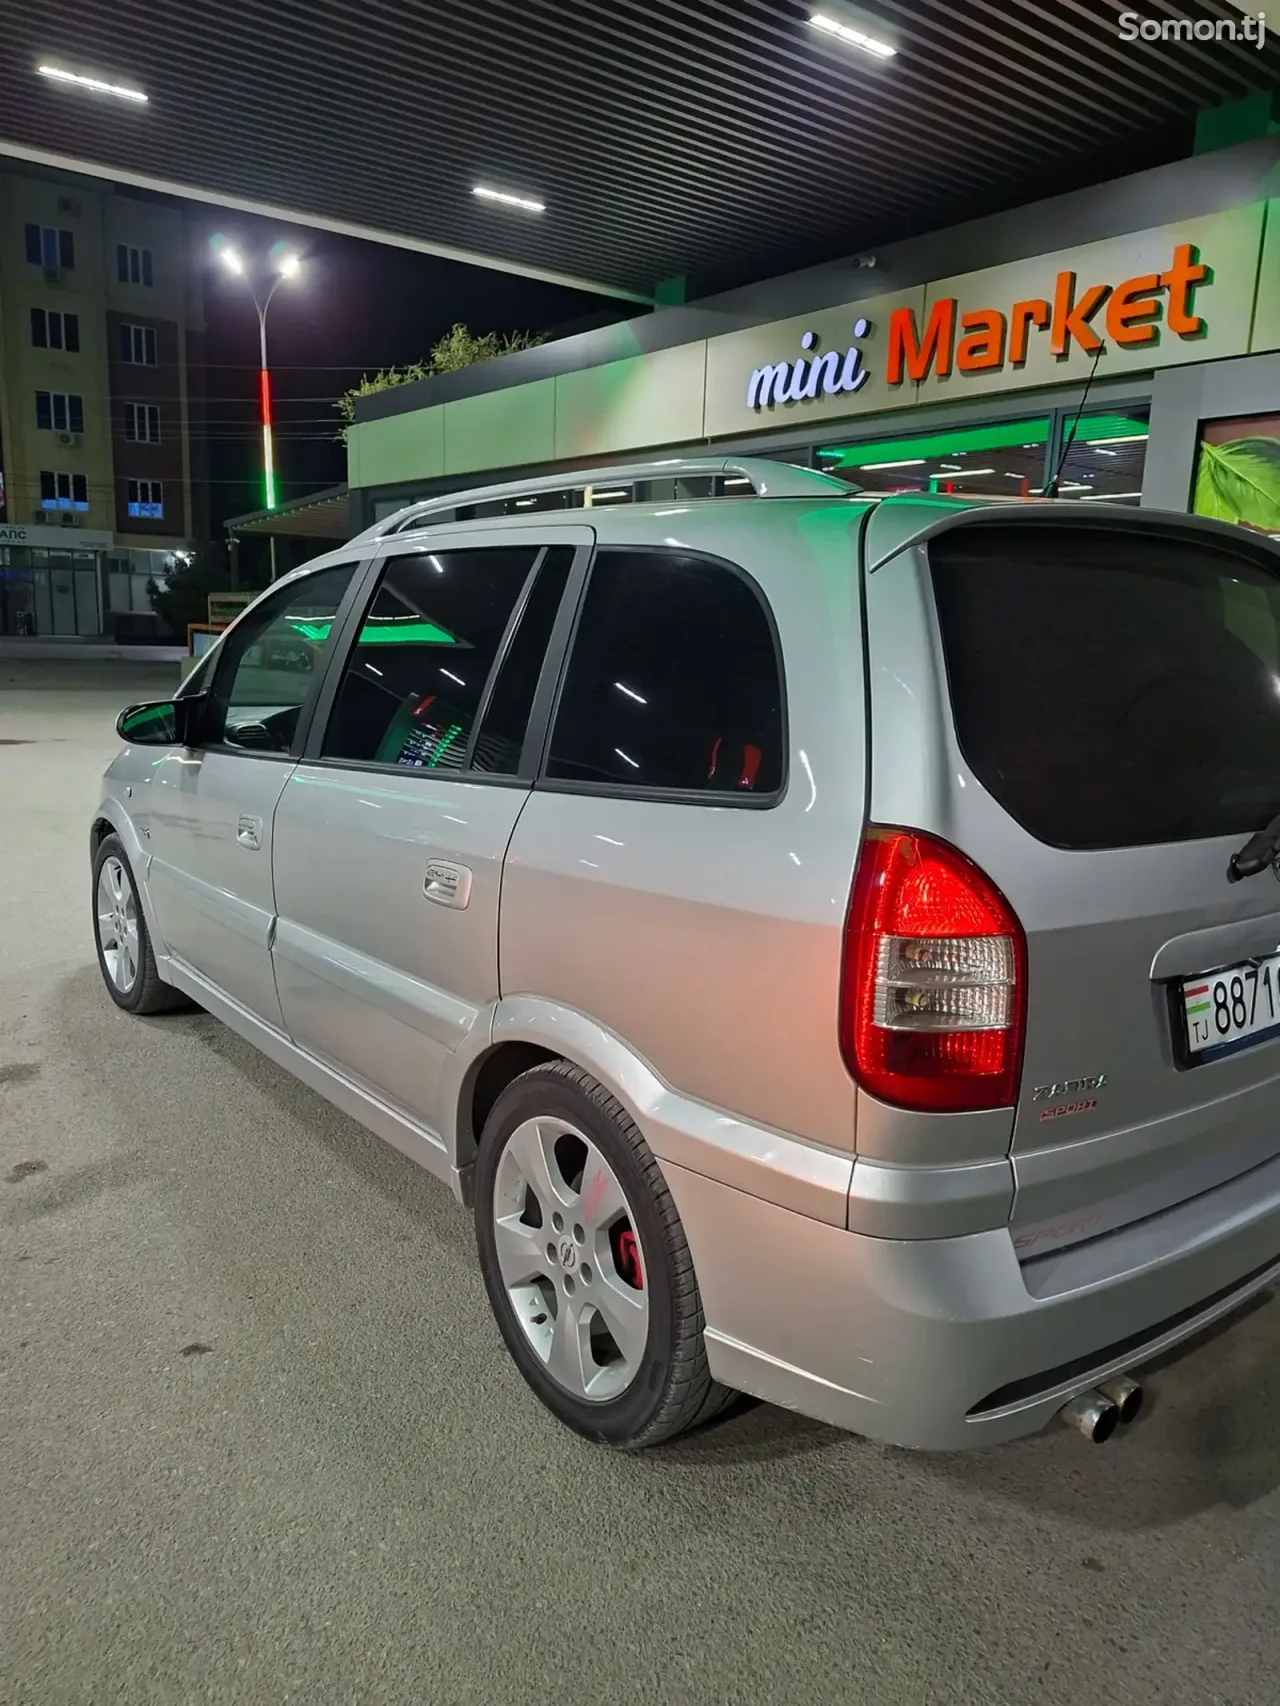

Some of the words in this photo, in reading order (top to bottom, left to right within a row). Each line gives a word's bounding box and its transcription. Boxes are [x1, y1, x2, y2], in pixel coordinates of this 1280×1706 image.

[747, 317, 870, 409] mini
[886, 243, 1208, 386] Market
[1193, 1019, 1209, 1043] TJ
[1213, 965, 1280, 1035] 8871
